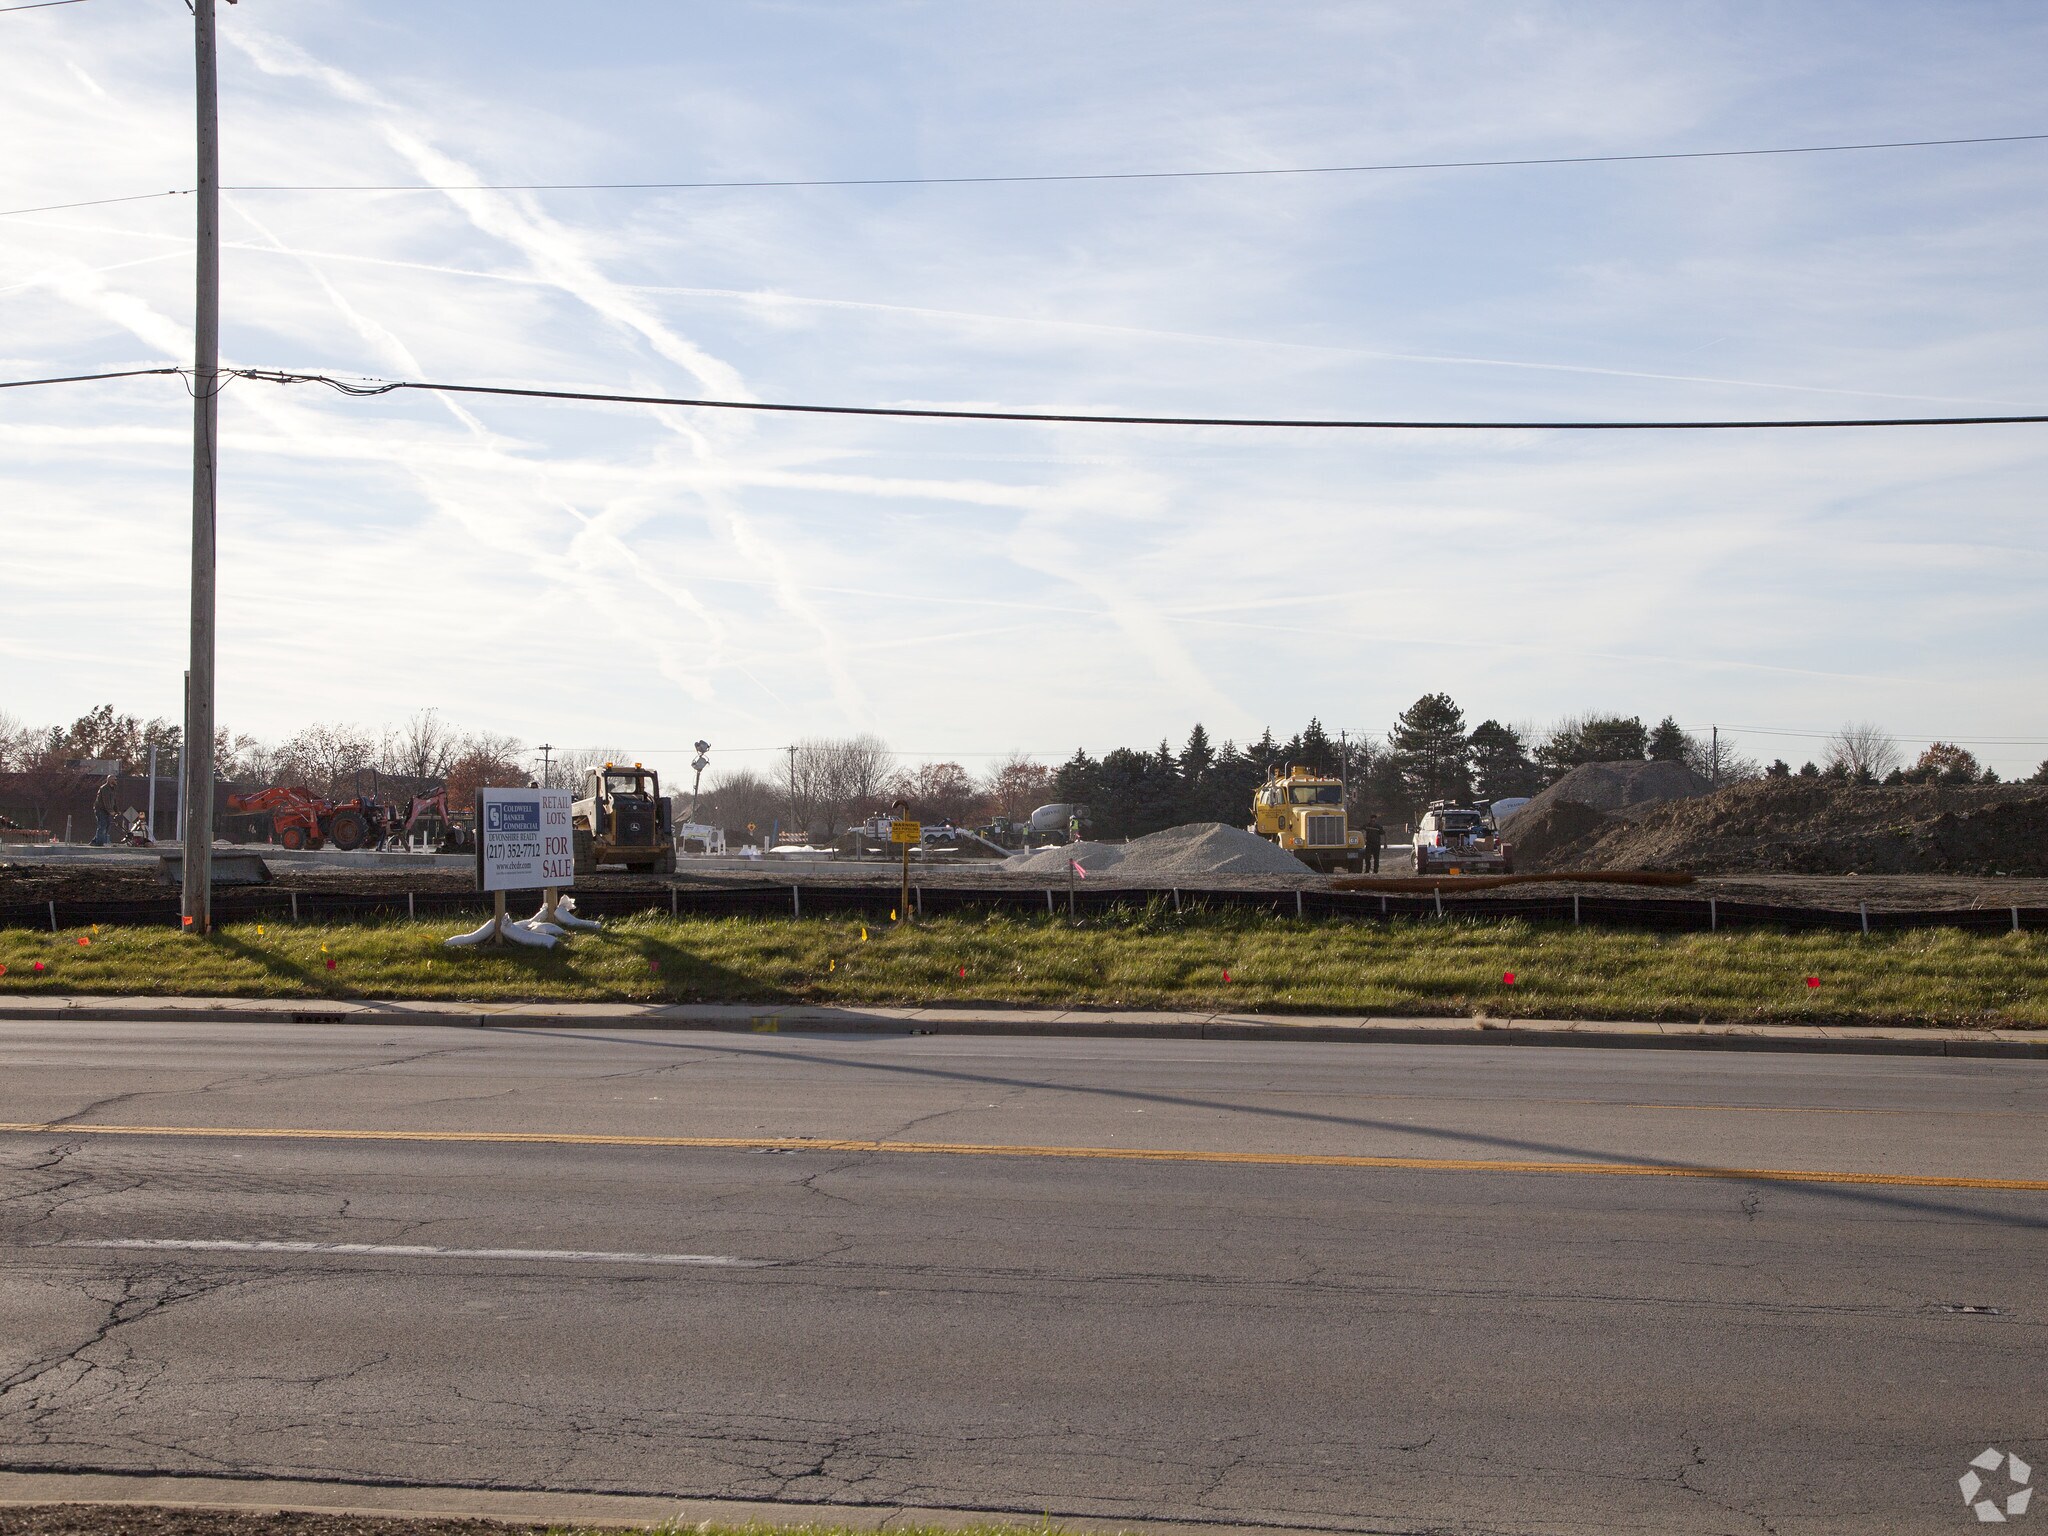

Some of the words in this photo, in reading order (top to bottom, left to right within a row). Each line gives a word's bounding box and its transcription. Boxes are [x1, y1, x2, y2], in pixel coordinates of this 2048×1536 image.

[503, 804, 533, 813] COLDWELL
[542, 796, 570, 809] RETAIL
[503, 813, 526, 821] BANKER
[546, 811, 567, 825] LOTS
[503, 822, 539, 830] COMMERCIAL
[488, 833, 520, 842] DEVONSHIRE
[520, 832, 538, 841] REALTY
[486, 843, 506, 861] (217)
[507, 843, 540, 858] 352-7712
[545, 836, 569, 856] FOR
[542, 859, 572, 878] SALE
